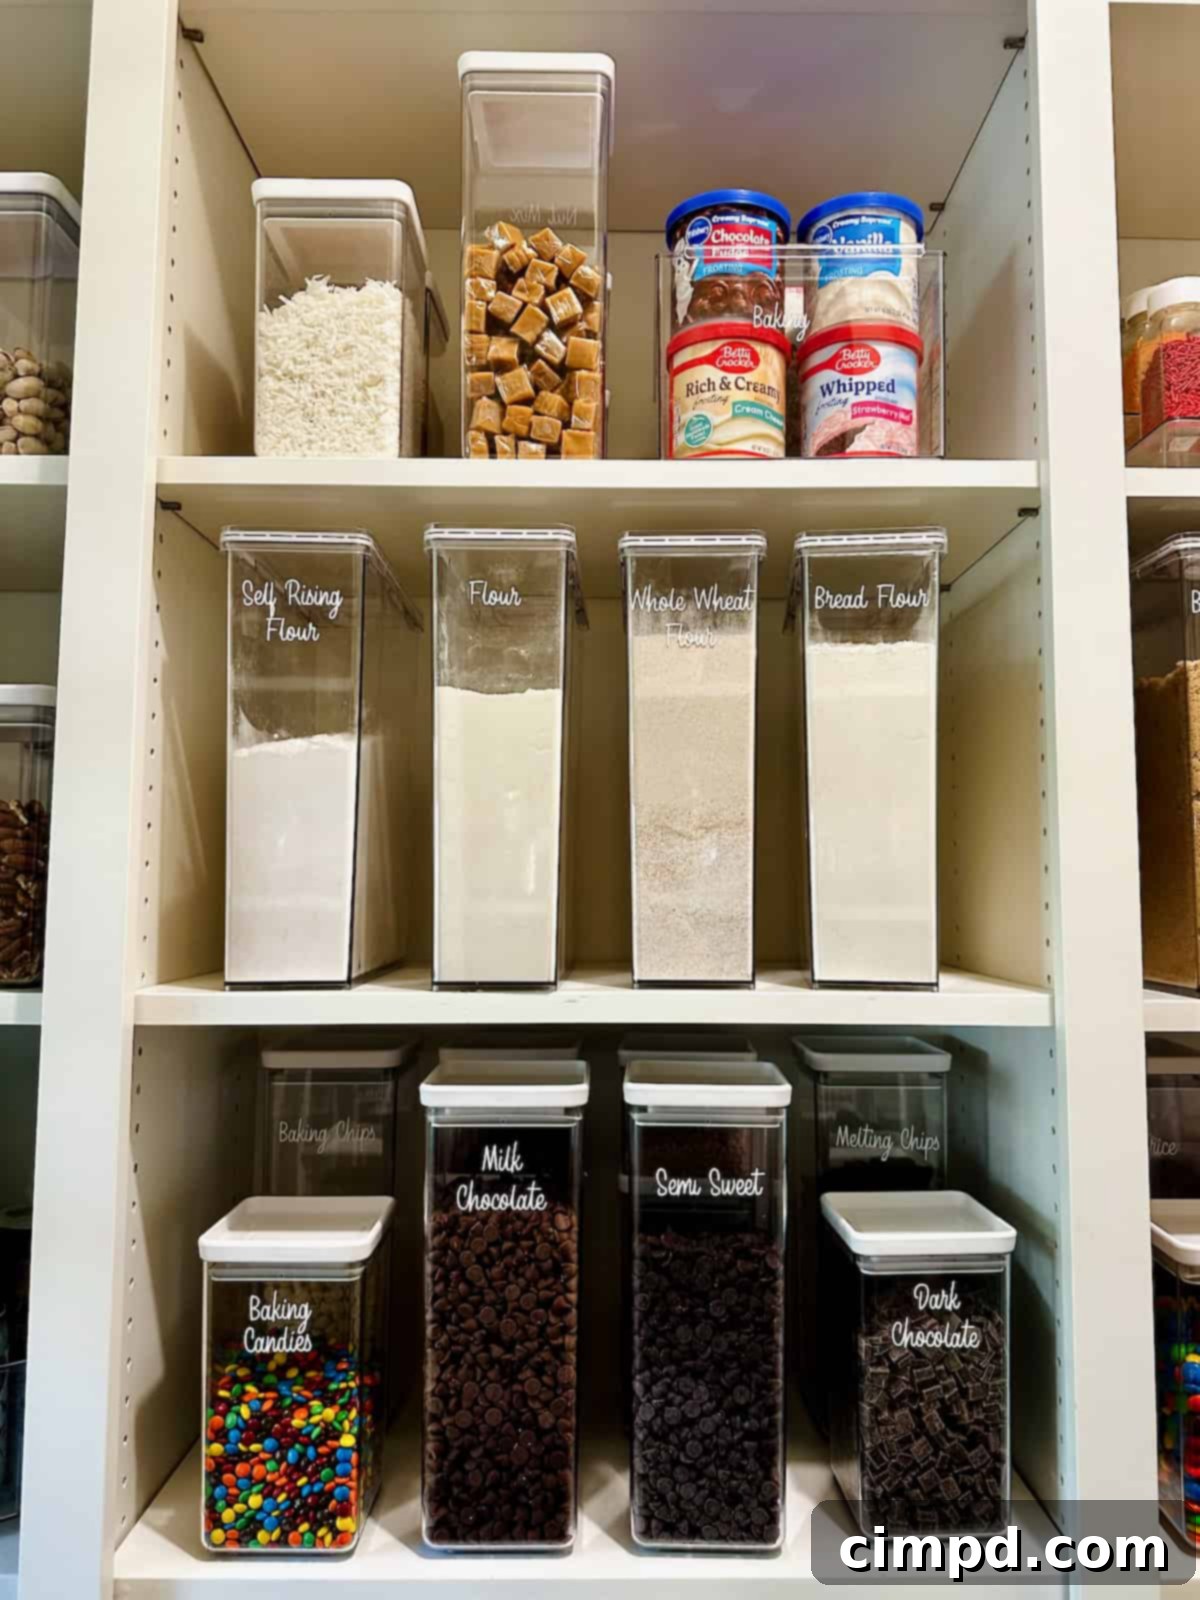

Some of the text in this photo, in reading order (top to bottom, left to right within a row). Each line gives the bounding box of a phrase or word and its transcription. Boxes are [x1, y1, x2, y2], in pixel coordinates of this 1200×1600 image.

[711, 229, 770, 246] Chocolate
[716, 356, 758, 369] Crocker
[723, 346, 751, 356] Betty
[835, 358, 877, 370] Crocker
[841, 348, 871, 360] Betty
[686, 377, 716, 398] Rich
[719, 376, 732, 391] &
[734, 376, 781, 404] Creamy
[820, 377, 896, 399] Whipped
[734, 404, 763, 416] Cream
[852, 406, 898, 420] Strawberry
[241, 579, 343, 619] Self Rising
[468, 579, 522, 607] Flour
[630, 583, 754, 612] Whole Wheat
[814, 583, 930, 610] Bread Flour
[1191, 589, 1200, 614] B
[265, 617, 320, 642] Flour
[664, 622, 718, 649] Flour
[278, 1119, 377, 1153] Baking Chips
[835, 1124, 941, 1161] Melting Chips
[481, 1141, 524, 1173] Milk
[655, 1167, 766, 1197] Semi Sweet
[455, 1180, 548, 1212] Chocolate
[913, 1280, 962, 1312] Dark
[249, 1289, 313, 1334] Baking
[243, 1326, 313, 1353] Candies
[891, 1317, 981, 1349] Chocolate
